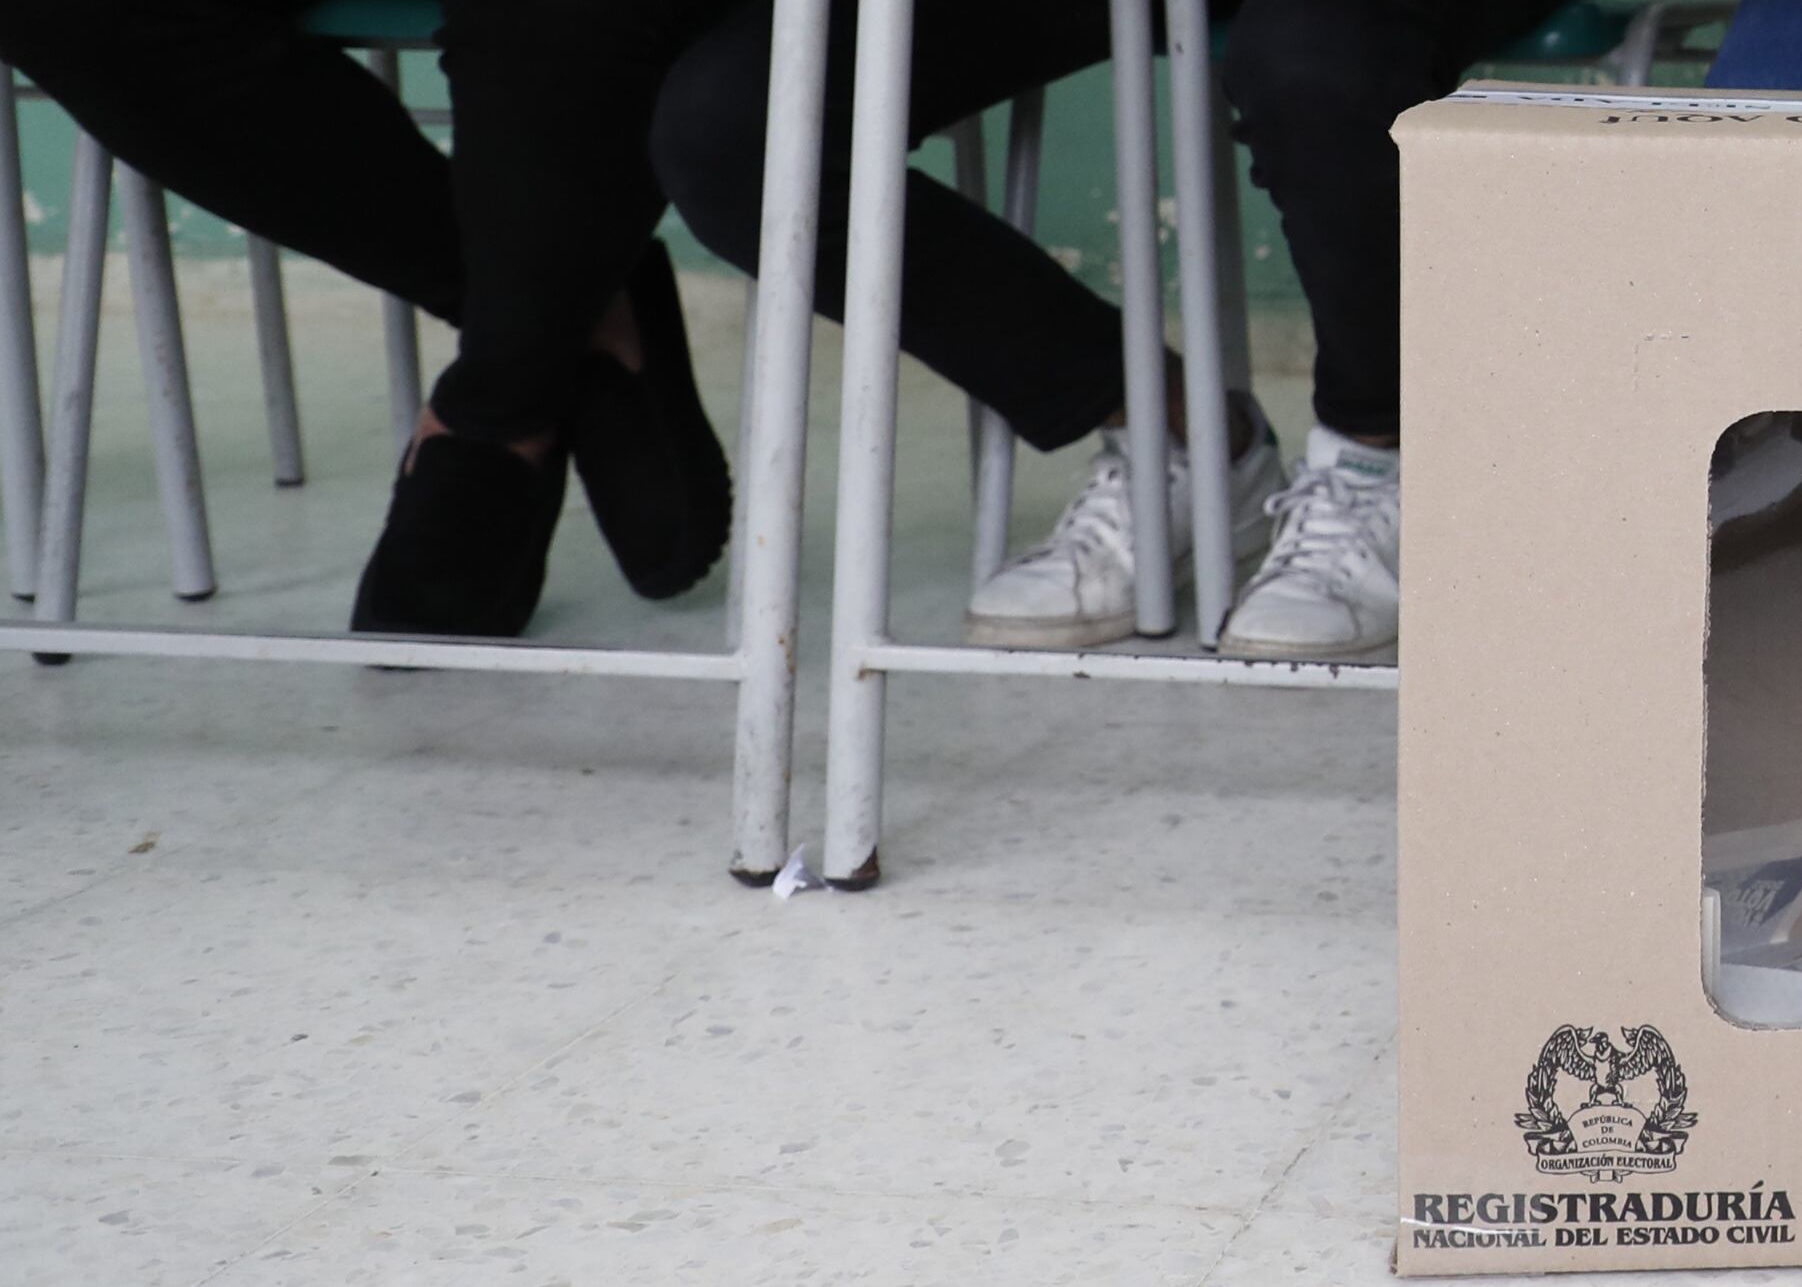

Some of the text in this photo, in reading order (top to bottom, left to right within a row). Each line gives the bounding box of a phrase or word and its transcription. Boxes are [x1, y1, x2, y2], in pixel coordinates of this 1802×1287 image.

[1601, 1126, 1614, 1134] DE
[1582, 1138, 1633, 1149] COLOMBIA
[1541, 1153, 1673, 1170] ORGANIZACIÓN ELECTORAL
[1413, 1180, 1796, 1224] REGISTRADURÍA
[1413, 1224, 1796, 1249] NACIONAL DEL ESTADO CIVIL
